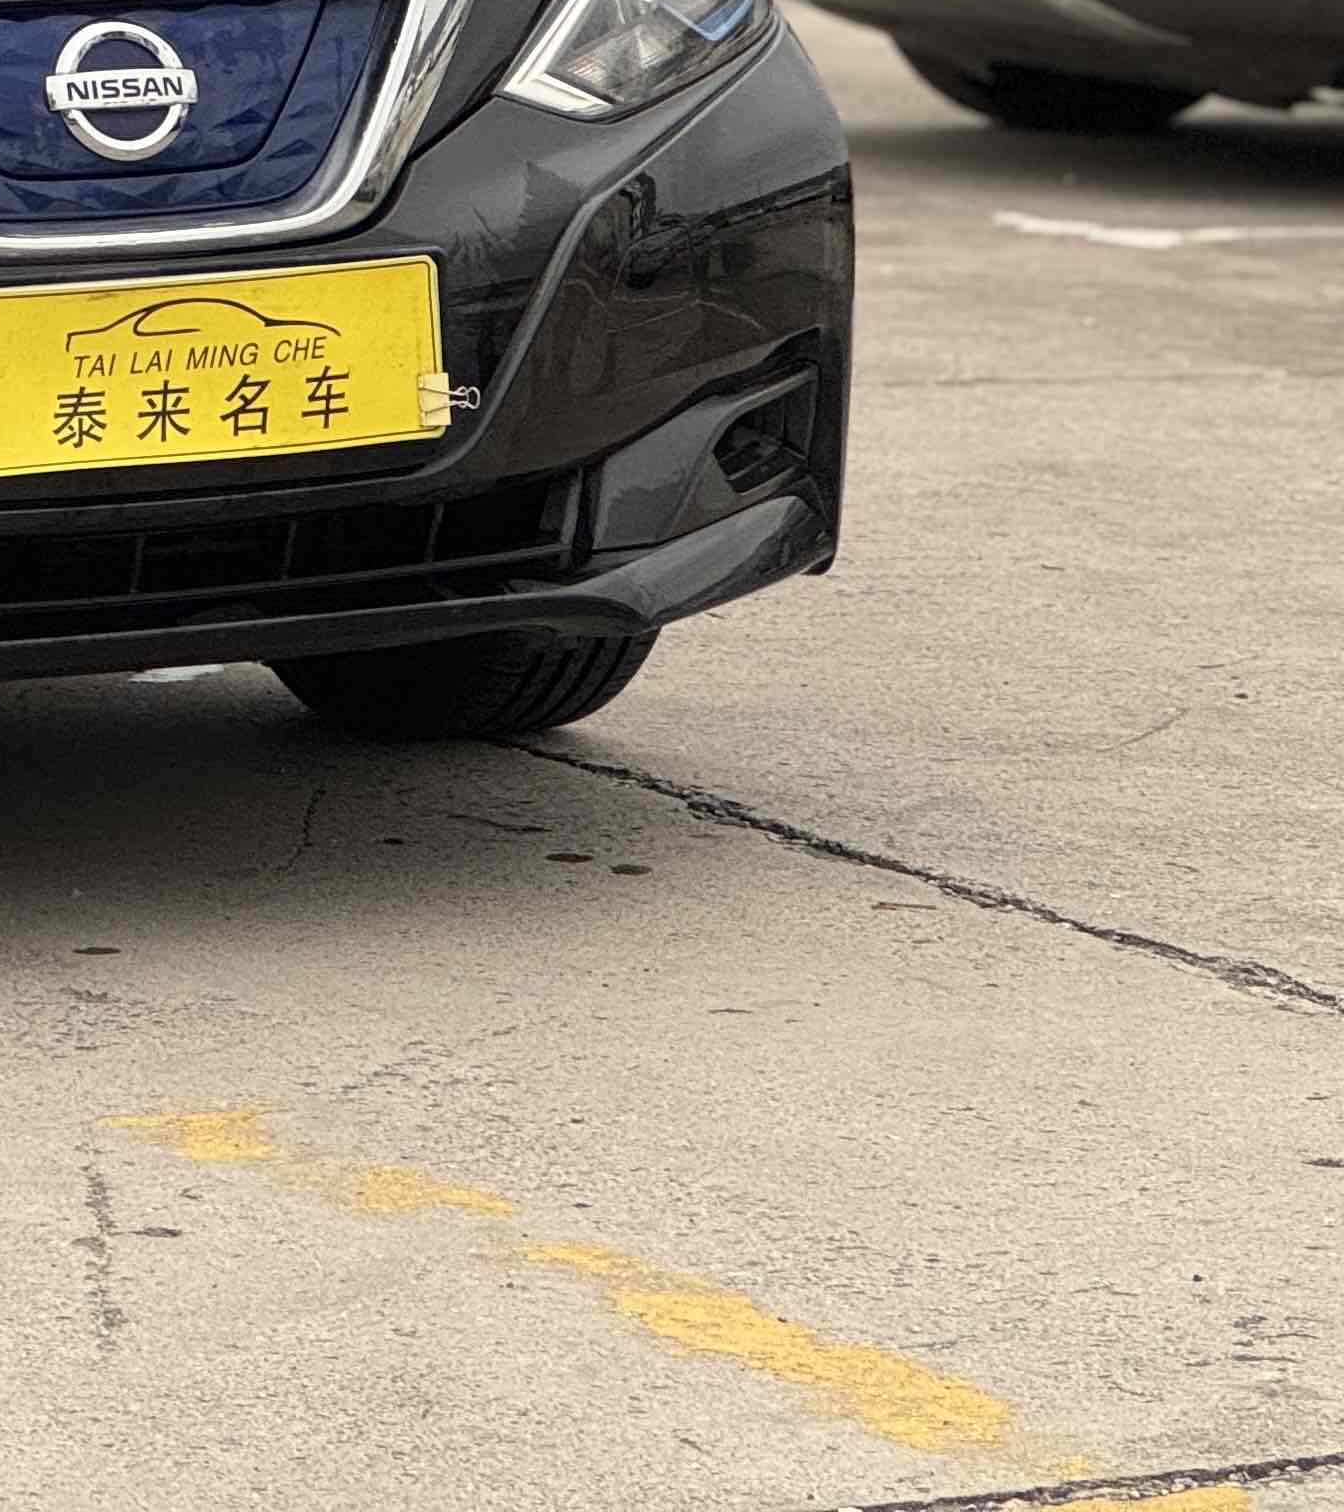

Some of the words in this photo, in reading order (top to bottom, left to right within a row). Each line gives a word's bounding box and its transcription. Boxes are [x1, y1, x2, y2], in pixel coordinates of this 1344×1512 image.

[65, 75, 184, 102] NISSAN
[73, 352, 117, 379] TAI
[129, 348, 173, 375] LAI
[185, 341, 260, 371] MING
[273, 335, 329, 364] CHE
[52, 365, 351, 449] 泰来名车
